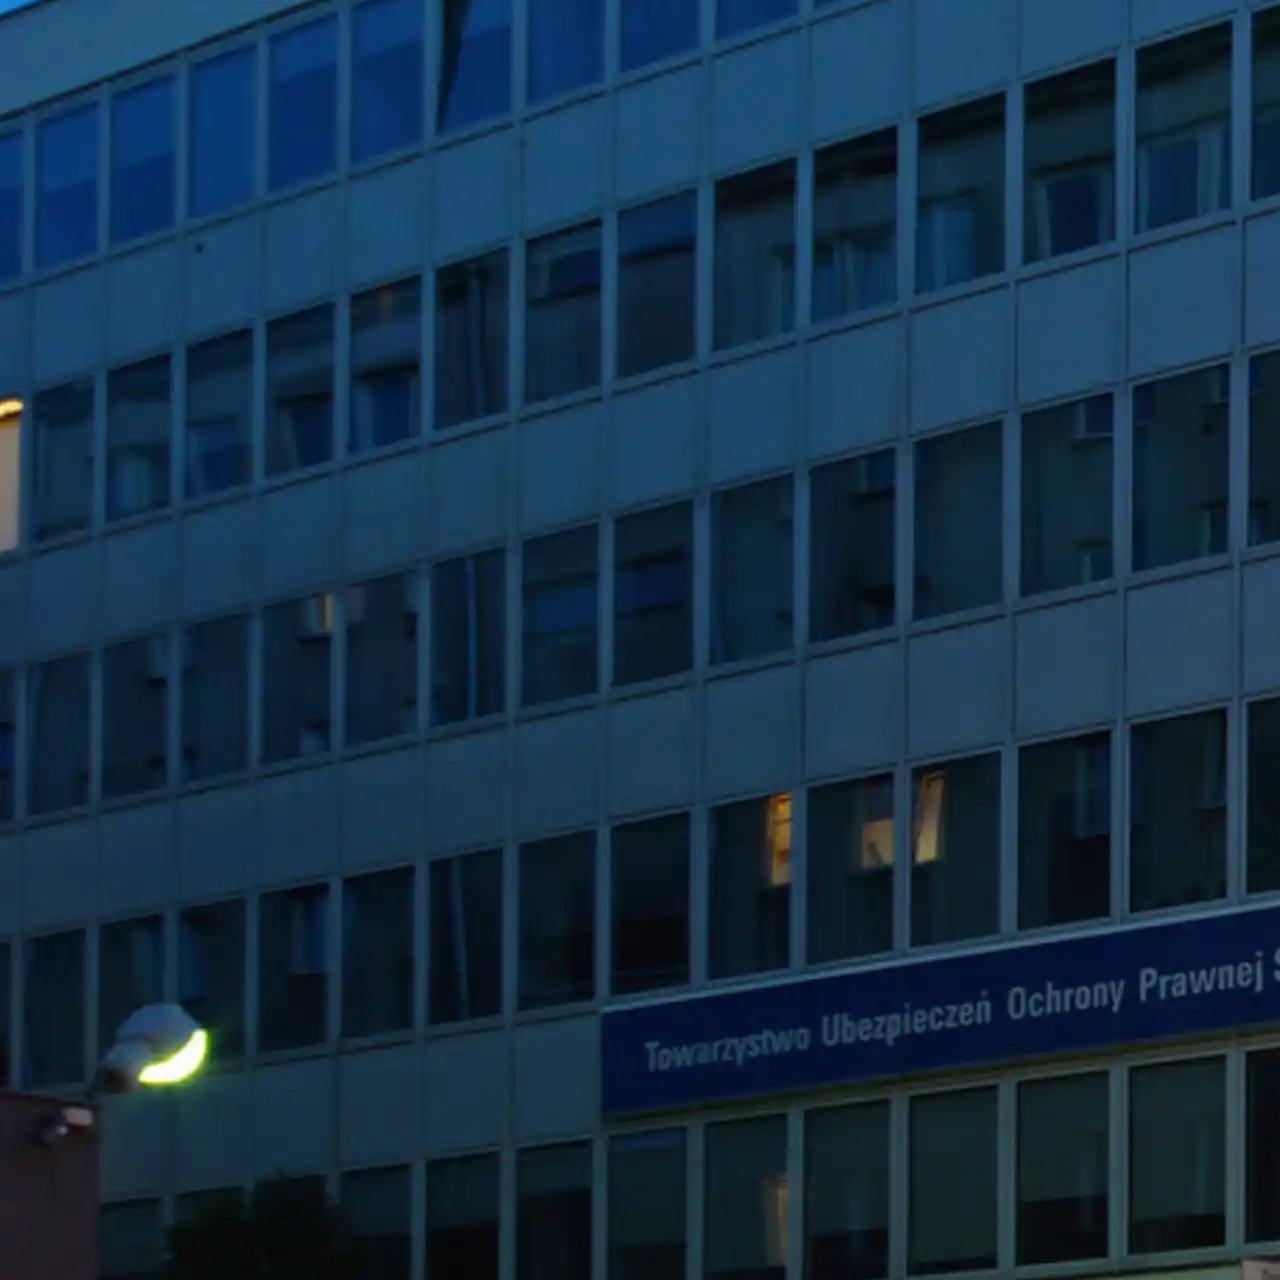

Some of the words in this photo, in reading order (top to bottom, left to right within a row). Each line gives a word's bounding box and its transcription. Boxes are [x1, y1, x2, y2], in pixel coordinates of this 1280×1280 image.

[645, 1026, 810, 1072] Towarzystwo
[822, 989, 991, 1047] Ubezpieczeń
[1007, 979, 1125, 1019] Ochrony
[1139, 949, 1264, 1003] Prawnej
